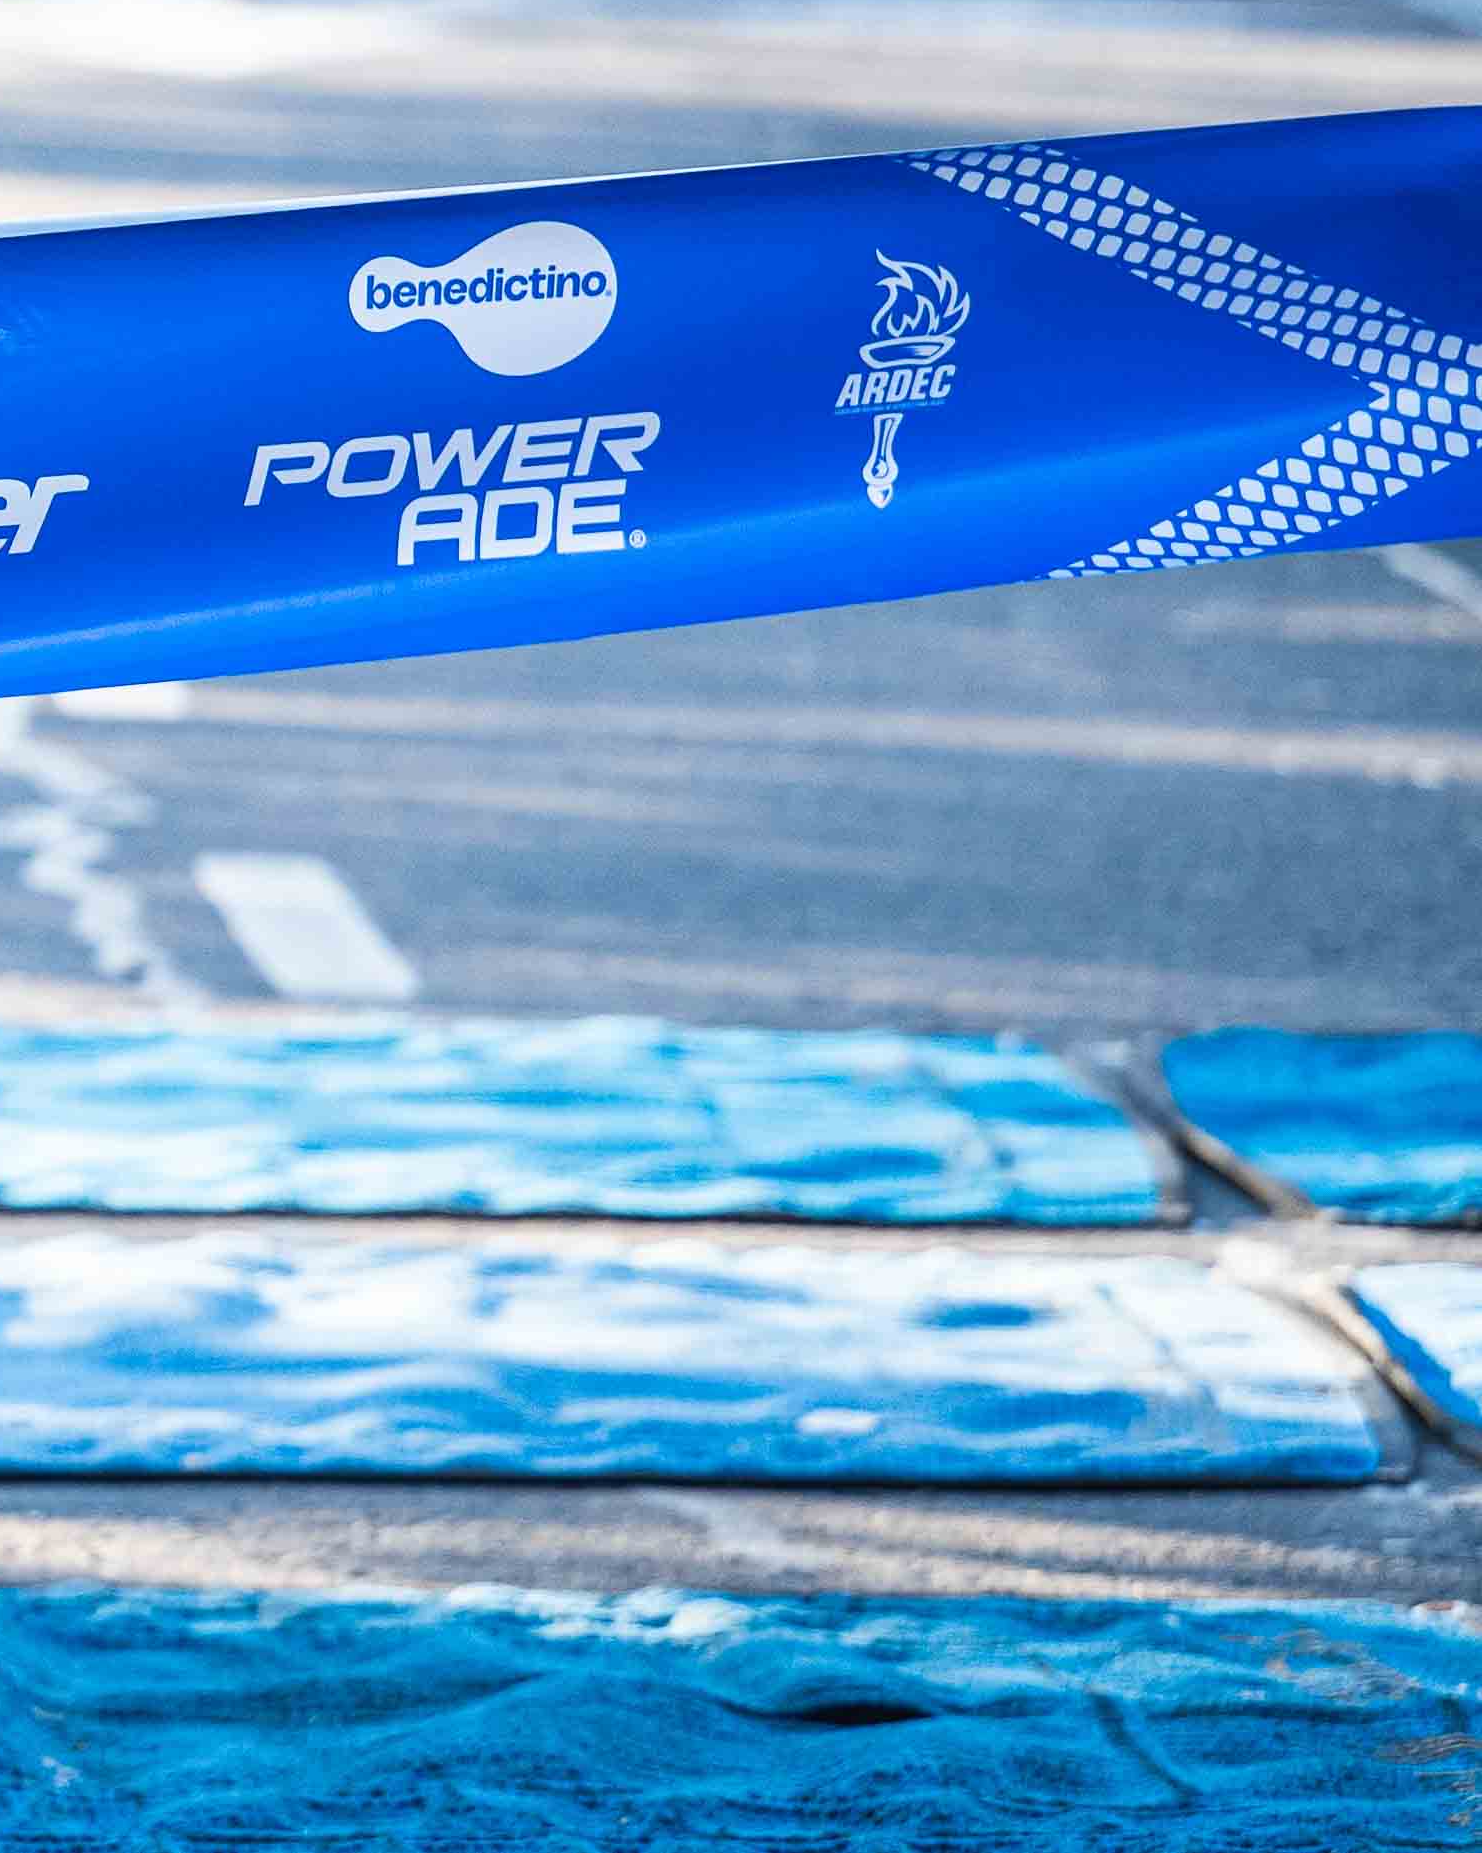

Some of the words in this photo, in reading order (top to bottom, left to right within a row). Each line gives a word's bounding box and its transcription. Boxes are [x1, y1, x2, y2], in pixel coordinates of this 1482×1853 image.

[366, 266, 607, 311] benedictino
[835, 364, 957, 408] ARDEC
[243, 411, 662, 508] POWER
